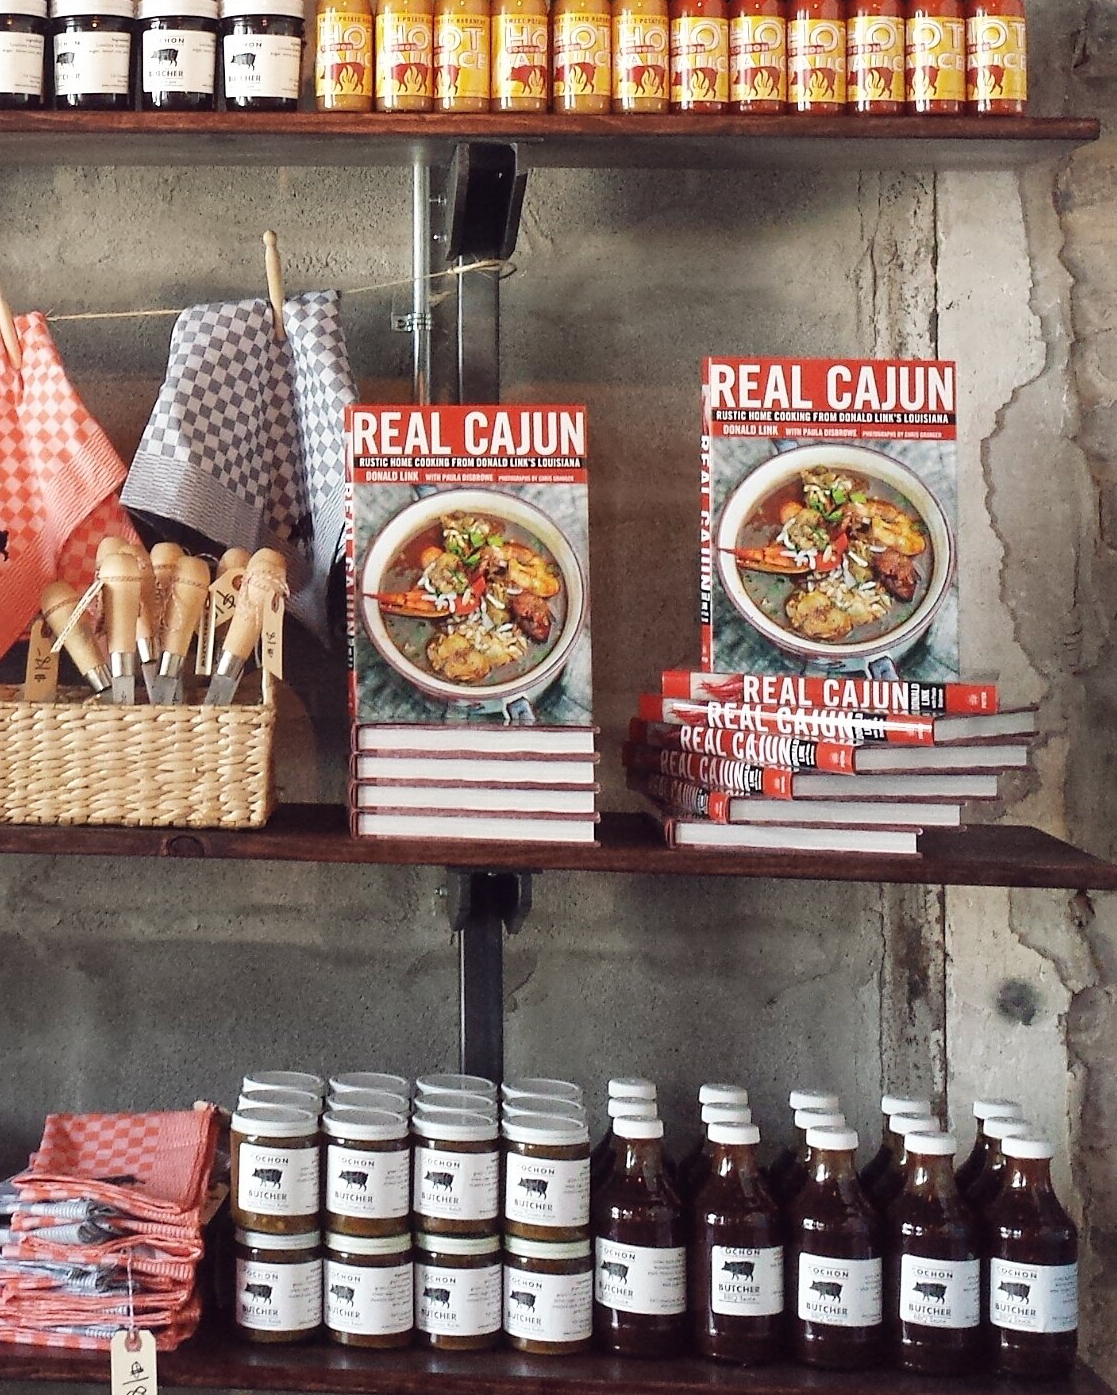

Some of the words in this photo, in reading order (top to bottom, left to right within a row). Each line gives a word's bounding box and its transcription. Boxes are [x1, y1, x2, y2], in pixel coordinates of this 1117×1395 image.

[439, 25, 483, 50] OT
[907, 20, 964, 50] OT
[711, 364, 812, 409] REAL
[826, 366, 953, 411] CAJUN
[716, 411, 747, 420] RUSTIC
[749, 412, 772, 421] HOME
[774, 412, 811, 421] COOKING
[813, 413, 837, 422] FROM
[839, 413, 873, 422] DONALD
[875, 413, 902, 423] LINK'S
[903, 414, 949, 424] LOUISIANA
[354, 411, 451, 455] REAL
[464, 411, 584, 455] CAJUN
[723, 425, 756, 435] DONALD
[758, 426, 778, 435] LINK
[785, 427, 801, 436] WITH
[803, 428, 823, 436] PAULA
[824, 428, 857, 437] DISBROWE
[360, 457, 388, 467] RUSTIC
[390, 458, 412, 467] HOME
[415, 458, 450, 467] COOKING
[451, 458, 474, 467] FROM
[476, 458, 508, 467] DONALD
[510, 458, 536, 467] LINK'S
[538, 458, 581, 468] LOUISIANA
[366, 472, 398, 481] DONALD
[400, 471, 419, 481] LINK
[442, 474, 461, 482] PAULA
[462, 474, 493, 482] DISBROWE
[743, 676, 812, 707] REAL
[823, 678, 909, 710] CAJUN
[707, 702, 769, 732] REAL
[776, 706, 855, 739] CAJUN
[680, 725, 726, 756] REAL
[732, 732, 793, 766] CAJUN
[661, 750, 695, 780] REAL
[699, 756, 745, 791] CAJUN
[253, 1155, 289, 1164] OCHON
[338, 1156, 374, 1167] OCHON
[425, 1158, 460, 1169] OCHON
[519, 1165, 554, 1174] OCHON
[249, 1190, 287, 1201] BUTCHER
[335, 1191, 373, 1203] BUTCHER
[422, 1192, 459, 1204] BUTCHER
[515, 1199, 553, 1211] BUTCHER
[602, 1247, 636, 1260] OCHON
[330, 1271, 361, 1282] OCHON
[810, 1267, 849, 1277] OCHON
[913, 1268, 953, 1278] OCHON
[998, 1267, 1037, 1278] OCHON
[423, 1273, 456, 1284] OCHON
[511, 1277, 542, 1289] OCHON
[719, 1284, 760, 1293] BUTCHER
[242, 1305, 278, 1316] BUTCHER
[421, 1309, 457, 1321] BUTCHER
[807, 1303, 848, 1315] BUTCHER
[909, 1303, 952, 1316] BUTCHER
[995, 1303, 1036, 1316] BUTCHER
[507, 1312, 542, 1325] BUTCHER
